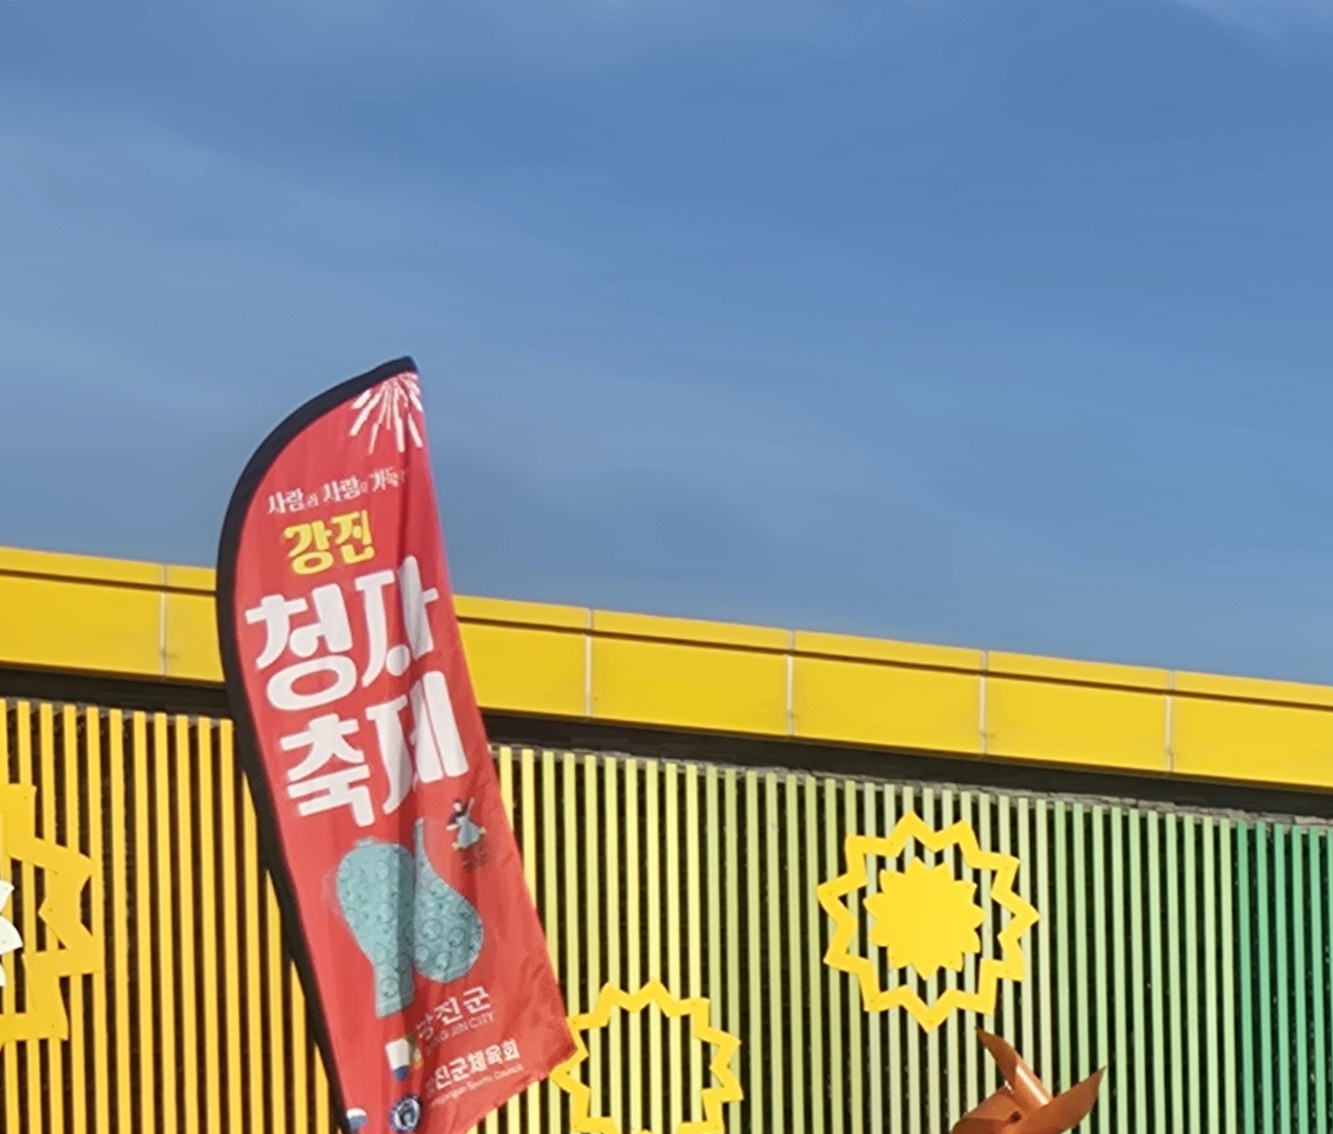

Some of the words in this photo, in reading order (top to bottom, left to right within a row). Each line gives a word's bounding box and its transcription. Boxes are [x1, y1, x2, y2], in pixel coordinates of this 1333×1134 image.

[283, 509, 376, 575] 강진
[244, 555, 439, 711] 청자
[279, 670, 469, 828] 축제
[427, 1038, 521, 1098] 진군체육회
